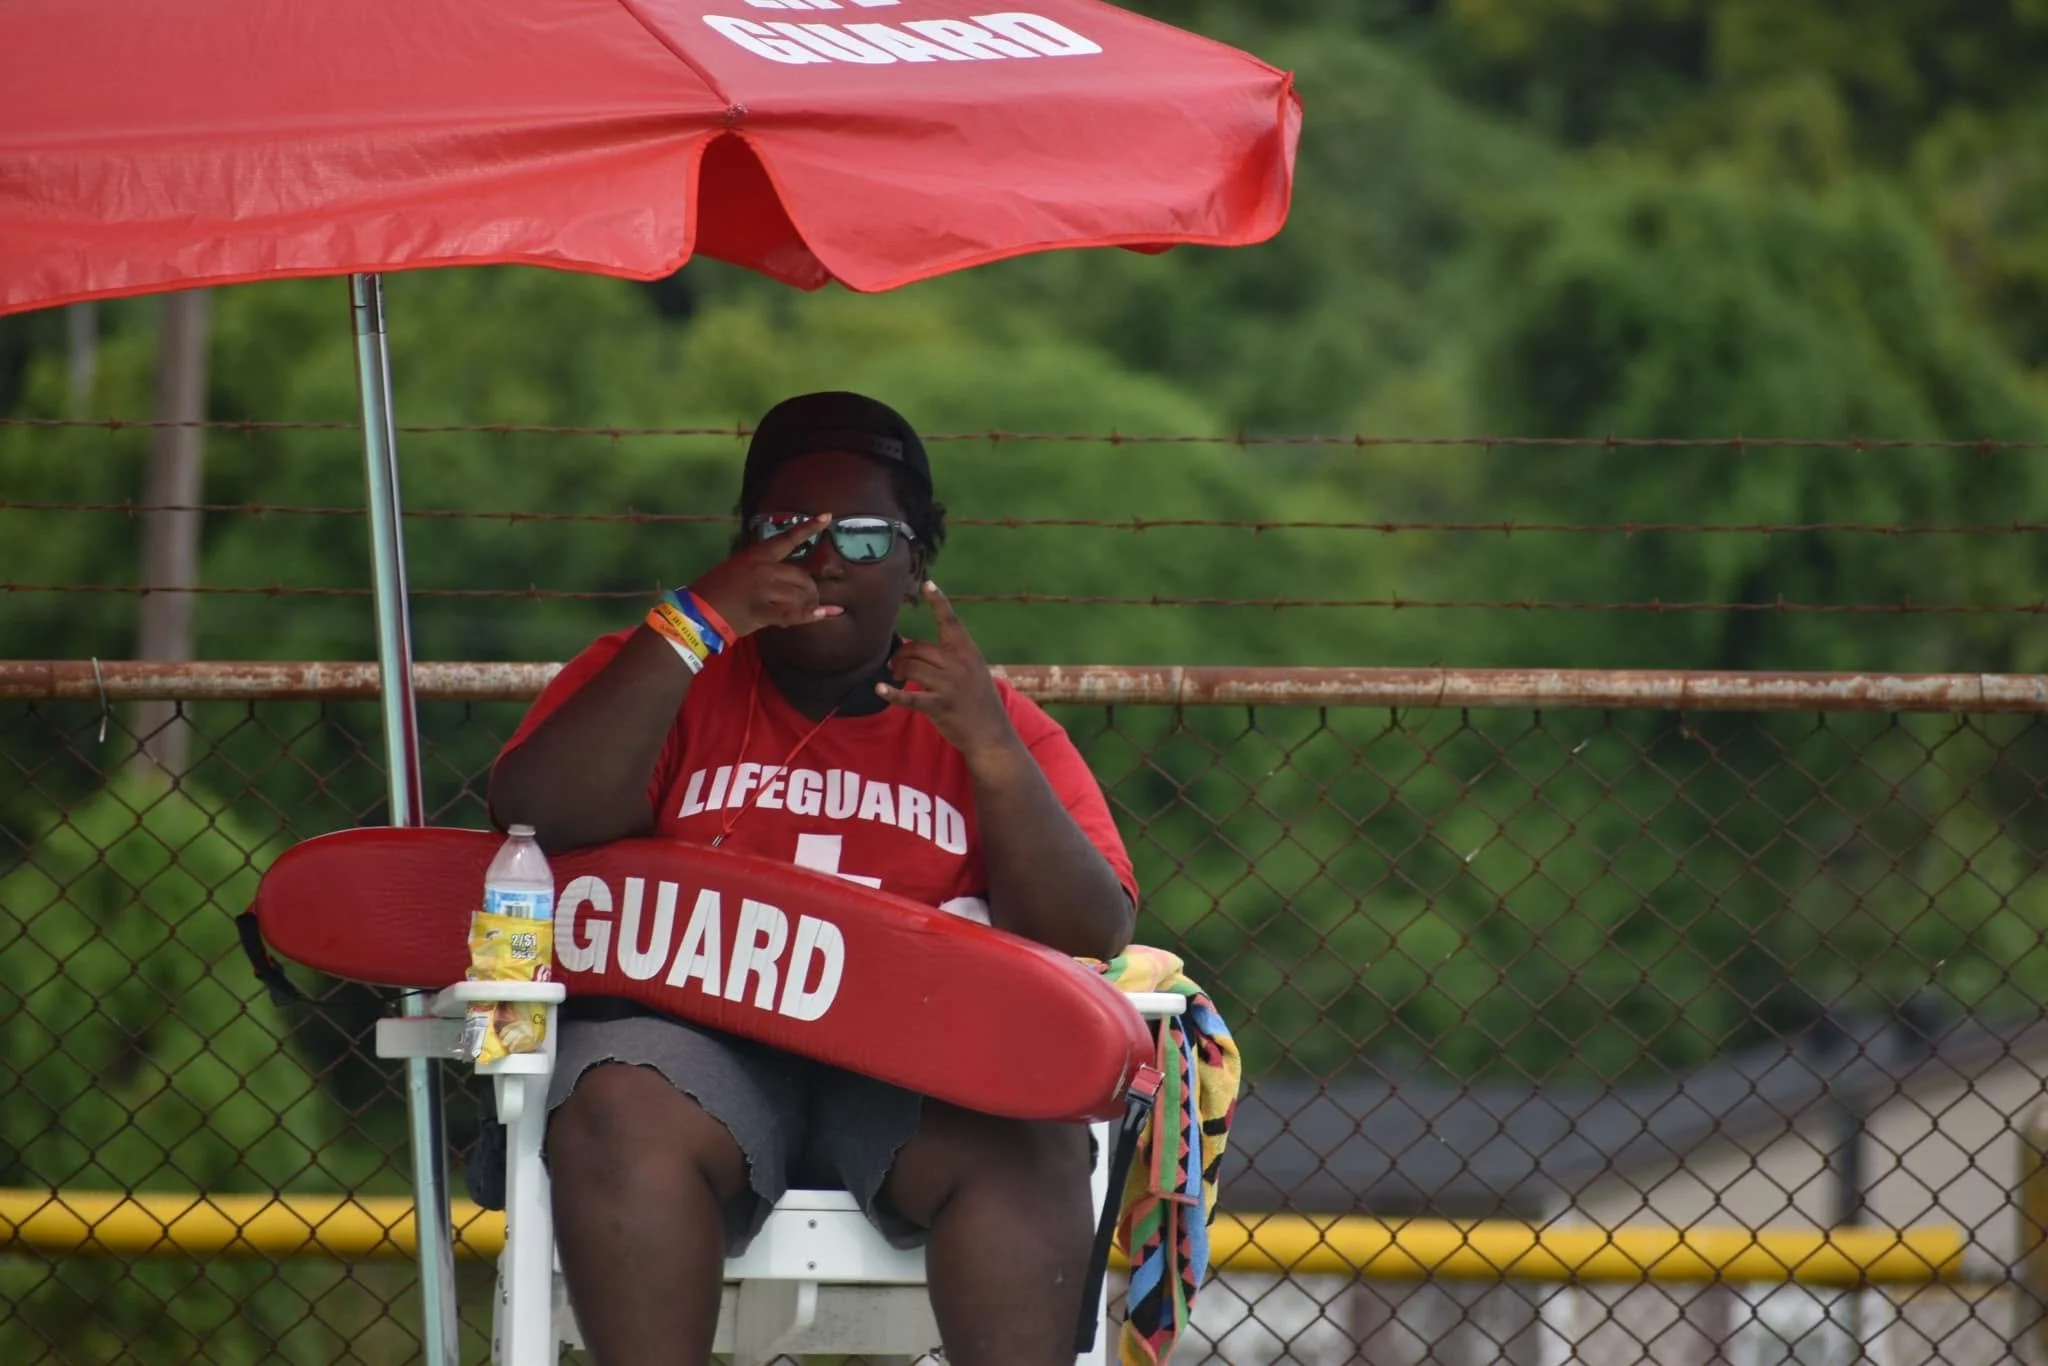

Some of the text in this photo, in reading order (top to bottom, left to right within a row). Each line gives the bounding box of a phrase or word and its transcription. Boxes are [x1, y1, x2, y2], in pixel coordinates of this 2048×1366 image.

[702, 12, 1103, 64] GUARD
[677, 762, 968, 856] LIFEGUARD
[553, 875, 846, 1022] GUARD
